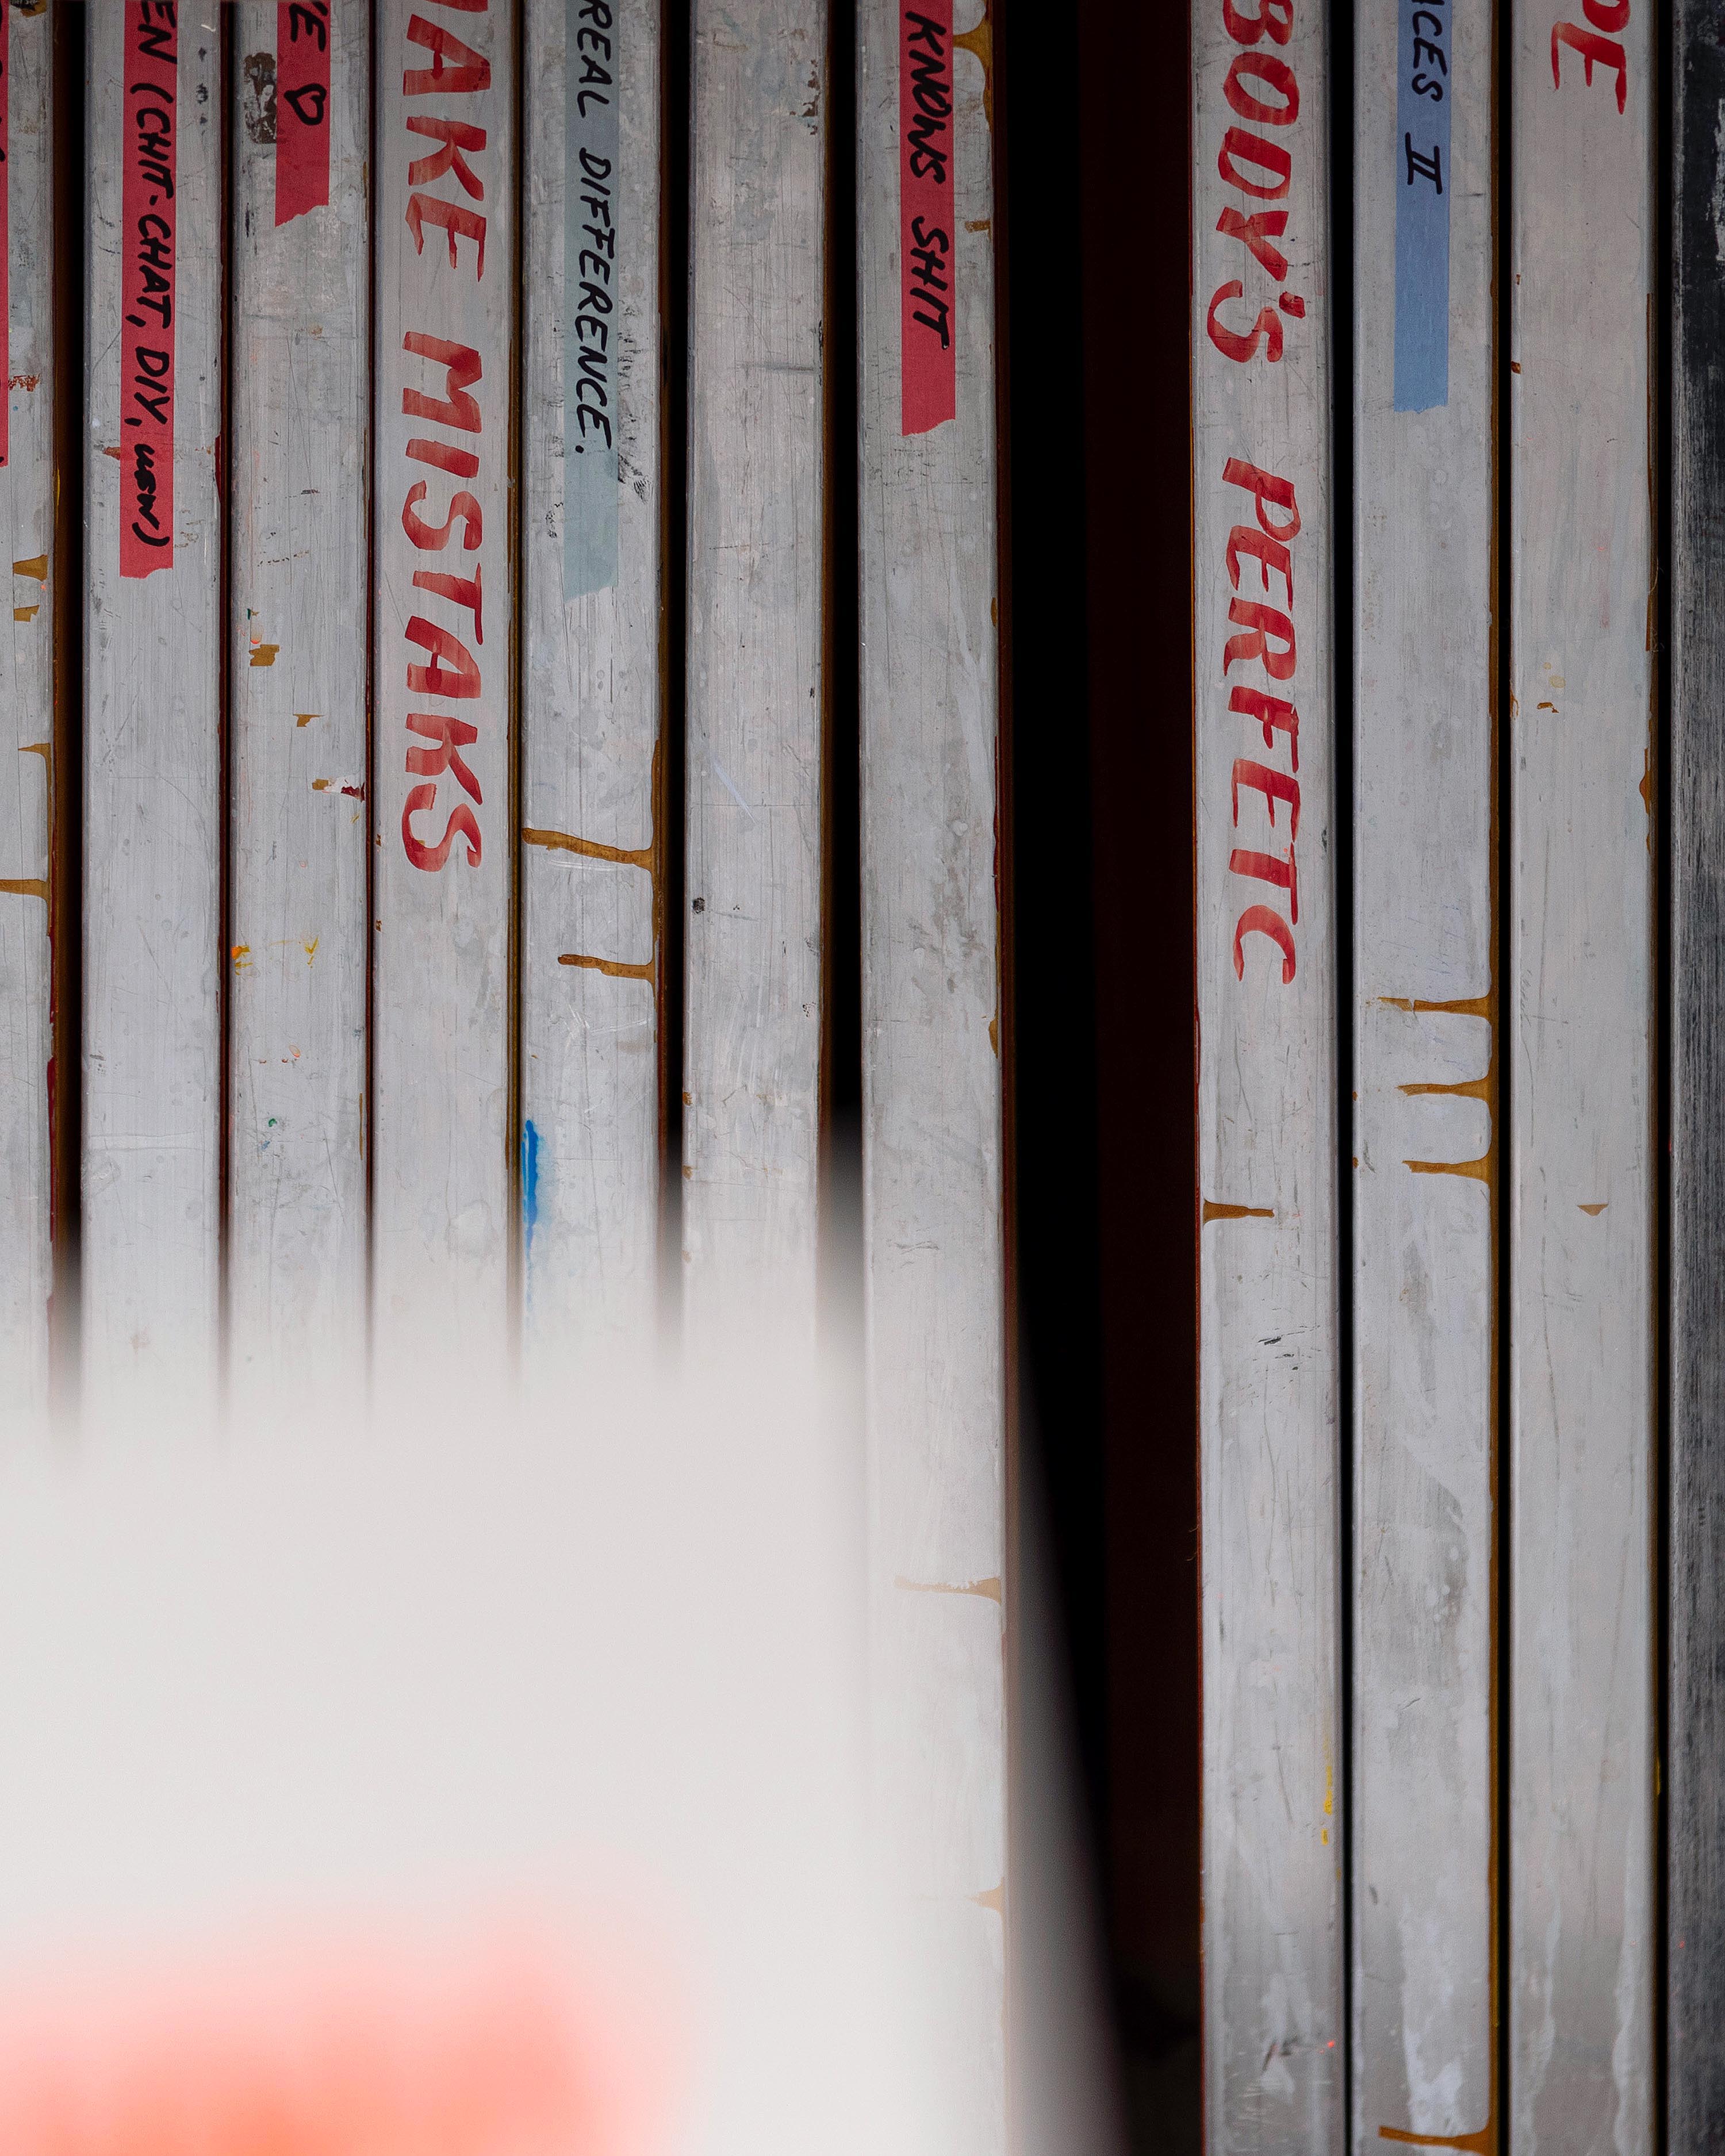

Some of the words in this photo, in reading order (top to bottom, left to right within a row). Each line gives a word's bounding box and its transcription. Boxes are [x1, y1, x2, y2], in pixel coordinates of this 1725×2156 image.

[287, 0, 328, 52] E
[577, 0, 612, 118] REAL
[906, 10, 953, 185] KNOWS
[402, 0, 491, 282] AKE
[575, 147, 615, 454] DIFFERENCE.
[911, 216, 950, 350] SHIT
[124, 346, 170, 427] DIY,
[402, 331, 482, 872] MISTAKS
[1221, 457, 1302, 984] PERFETC
